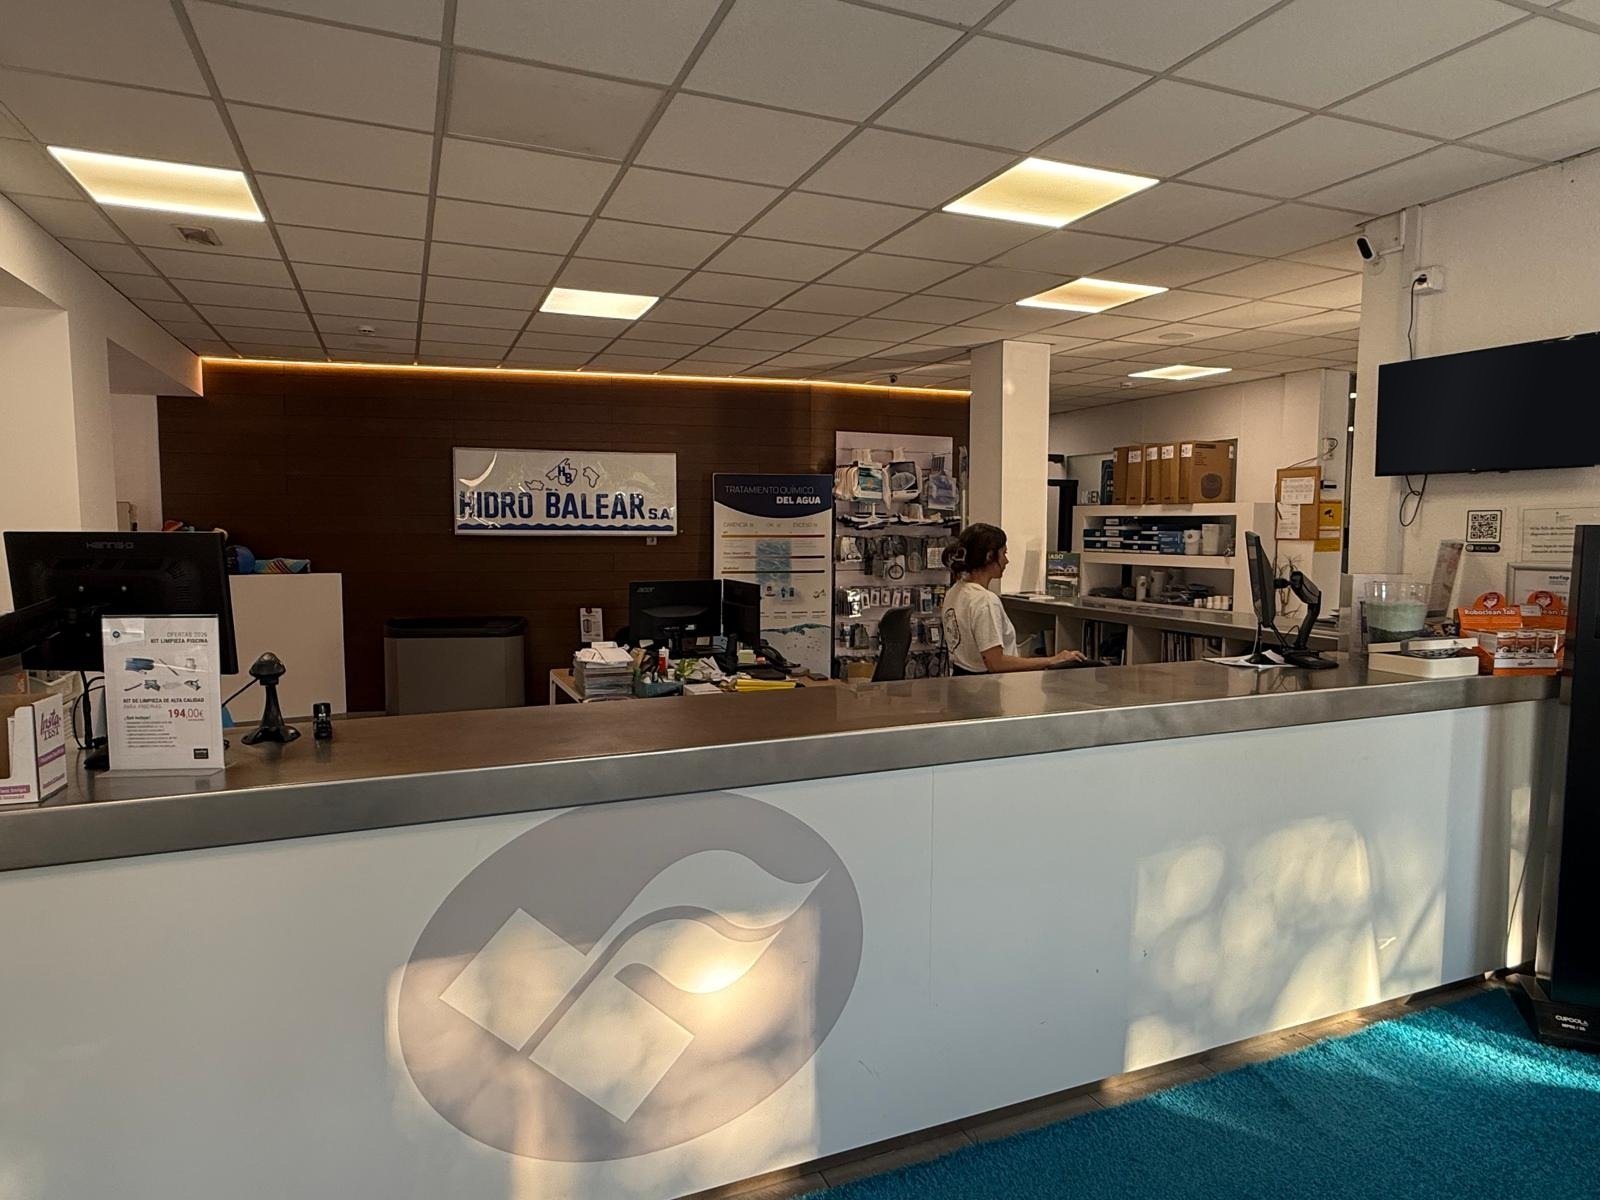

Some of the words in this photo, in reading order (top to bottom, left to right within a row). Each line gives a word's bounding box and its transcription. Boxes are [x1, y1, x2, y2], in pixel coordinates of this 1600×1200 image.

[725, 485, 780, 495] TRATAMIENTO
[780, 484, 814, 495] QUÍMICO
[458, 490, 533, 519] HIDRO
[545, 491, 646, 520] BALEAR
[776, 496, 795, 504] DEL
[796, 496, 821, 505] AGUA
[168, 708, 204, 719] 194,00€
[44, 728, 60, 741] TEST
